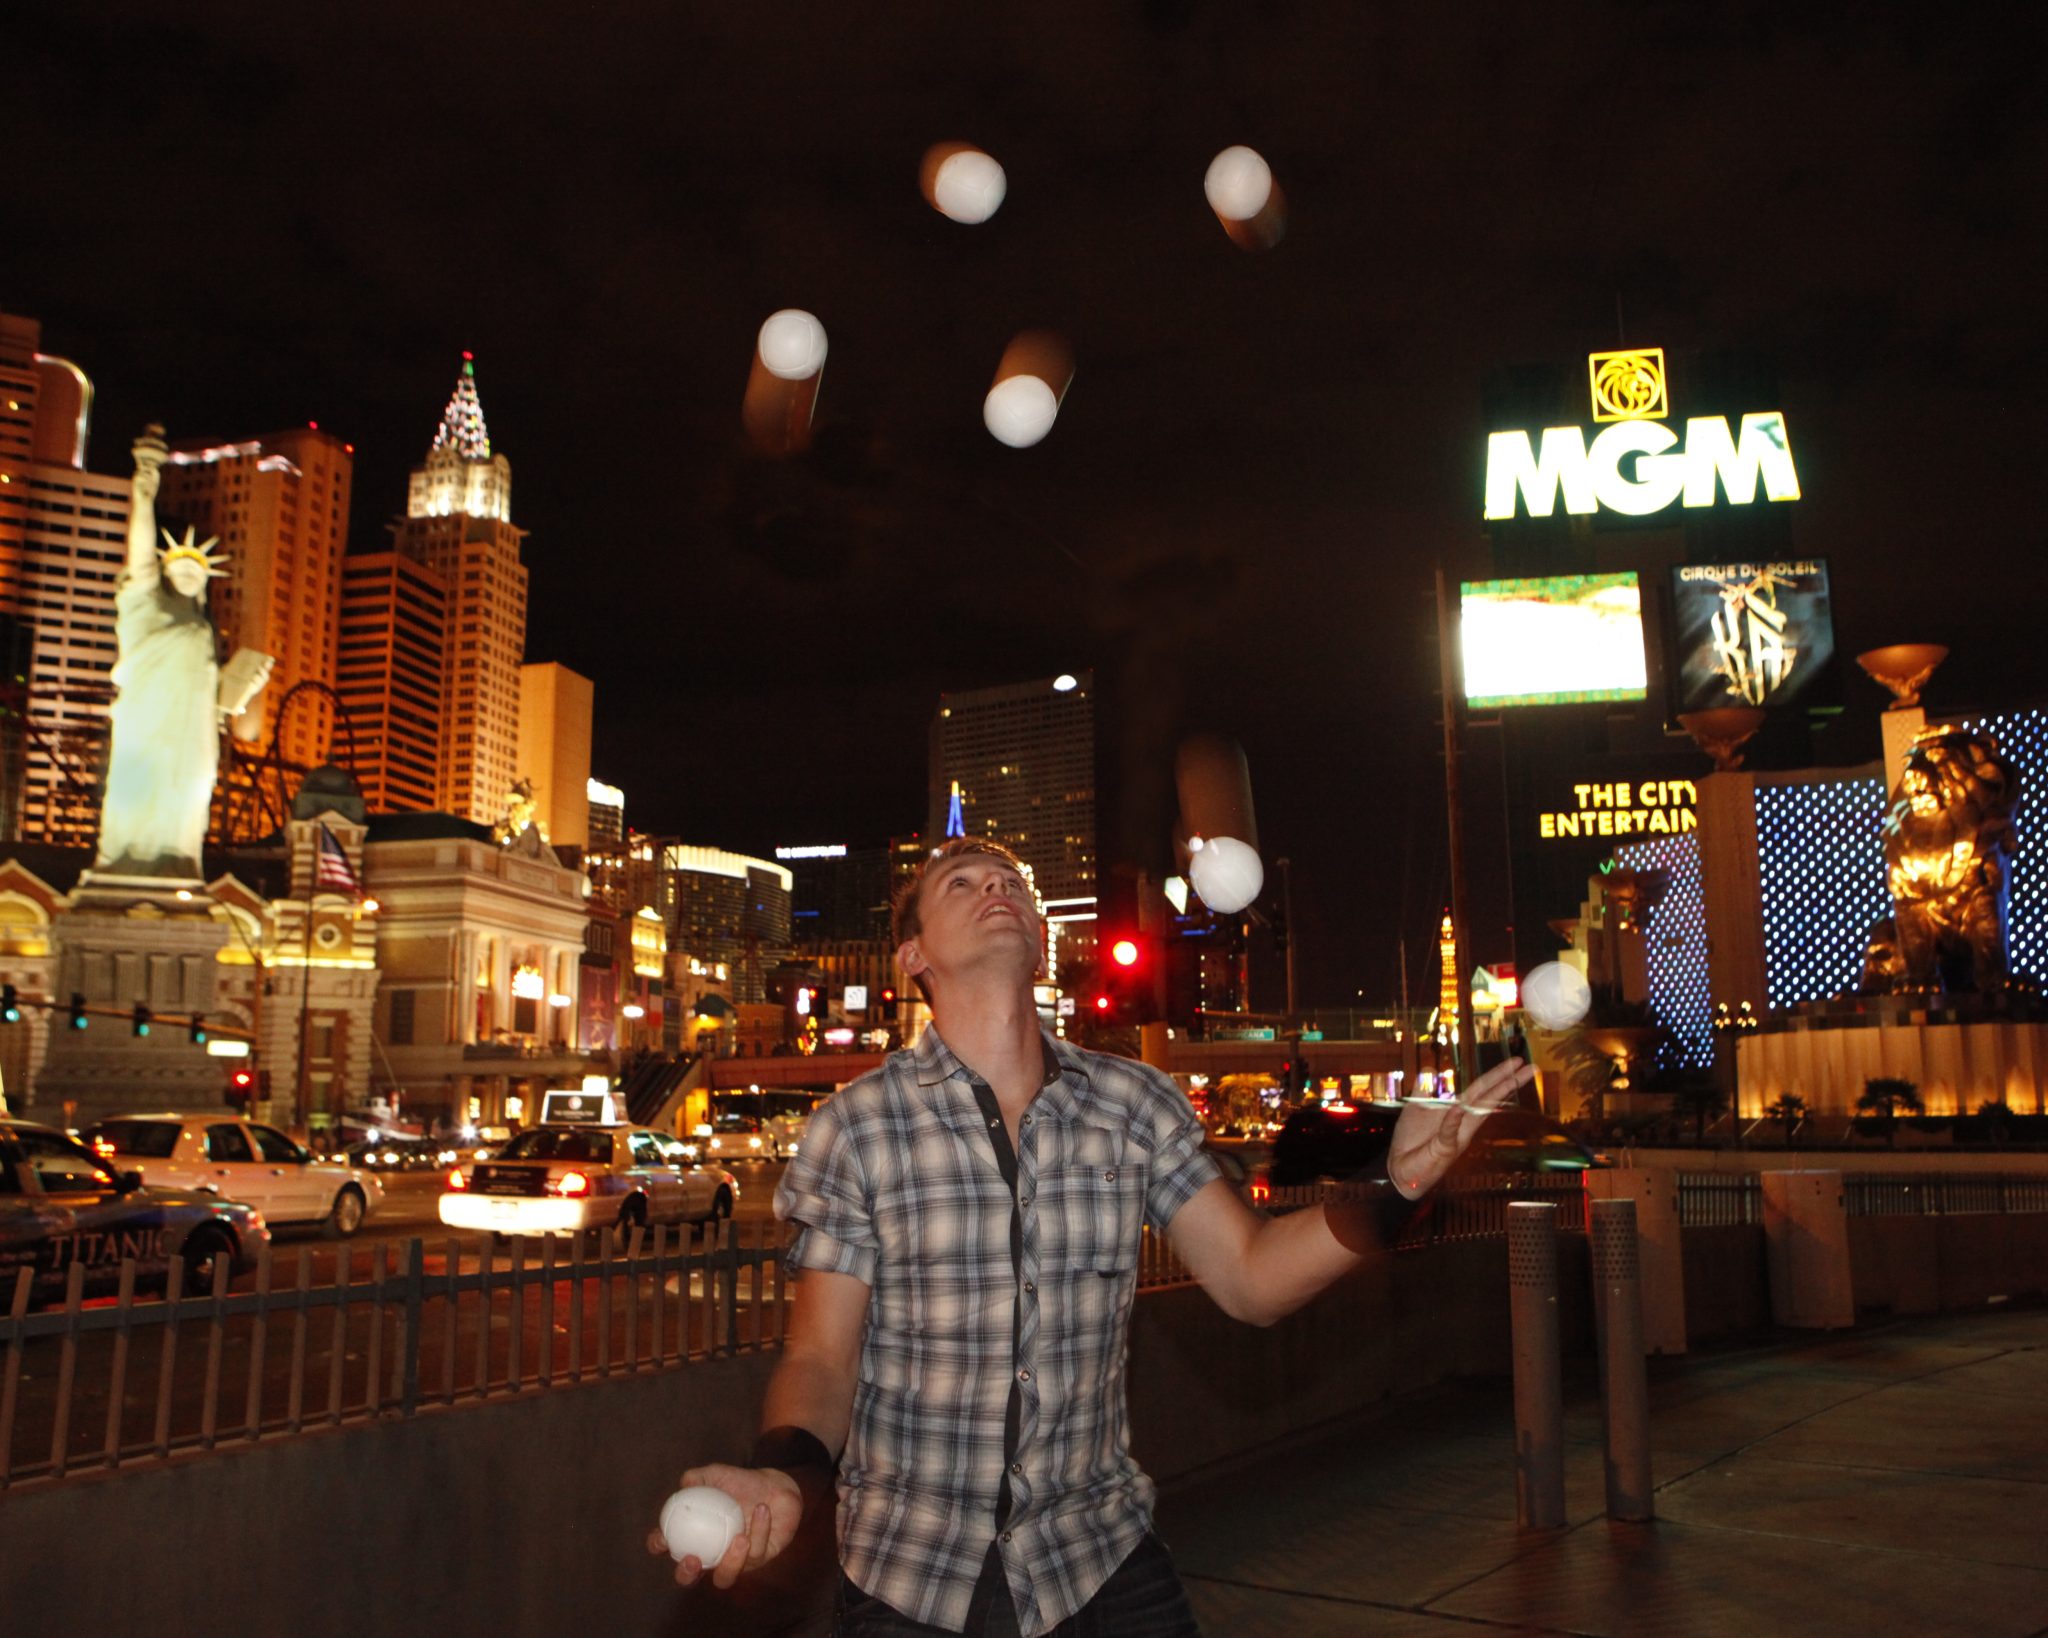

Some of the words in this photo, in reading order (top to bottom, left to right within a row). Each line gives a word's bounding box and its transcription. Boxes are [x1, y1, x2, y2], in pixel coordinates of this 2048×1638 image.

[1484, 412, 1800, 520] MGM
[1680, 565, 1736, 582] CIRQUE
[1740, 564, 1761, 578] DU
[1765, 561, 1819, 577] SOLEIL
[1574, 783, 1631, 809] THE
[1639, 780, 1697, 807] CITY
[50, 1228, 176, 1268] TITANIC
